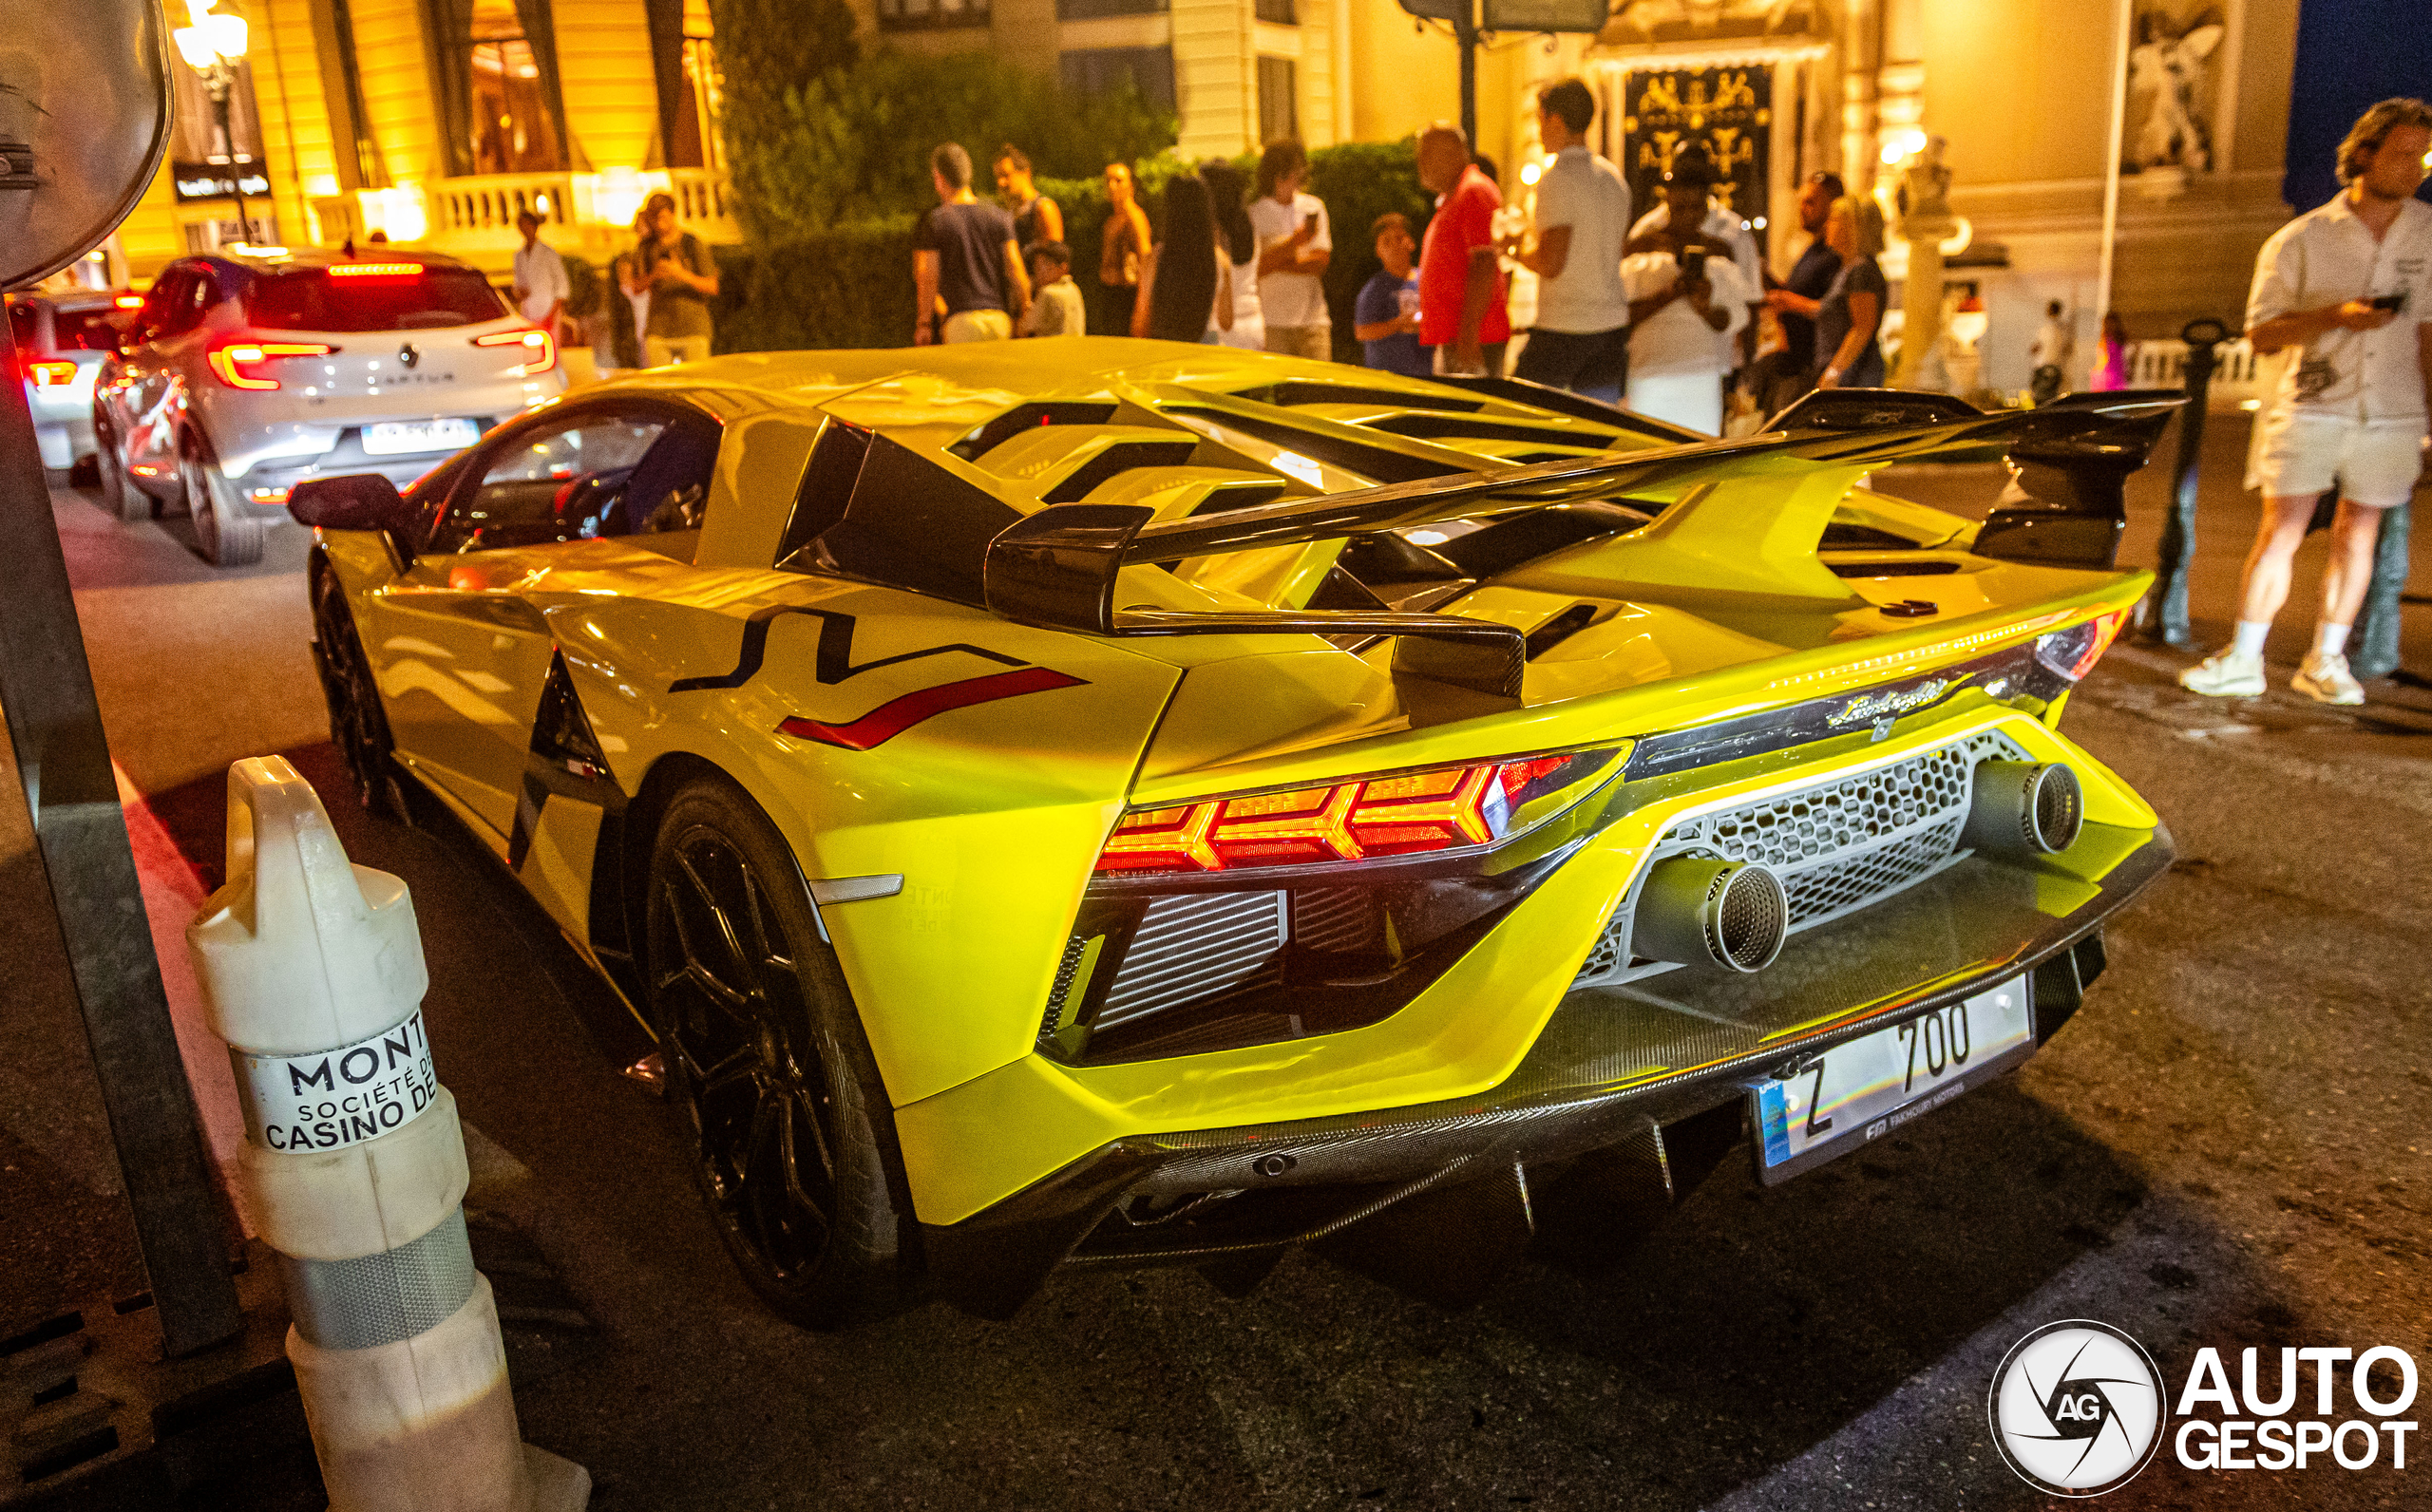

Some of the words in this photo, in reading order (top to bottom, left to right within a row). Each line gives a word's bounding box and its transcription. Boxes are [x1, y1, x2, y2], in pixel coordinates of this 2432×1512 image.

[266, 1101, 404, 1150] CASINO
[410, 1070, 436, 1113] DE
[298, 1066, 416, 1122] SOCIÉTÉ
[1799, 1056, 1833, 1138] Z
[1898, 1002, 1970, 1093] 700
